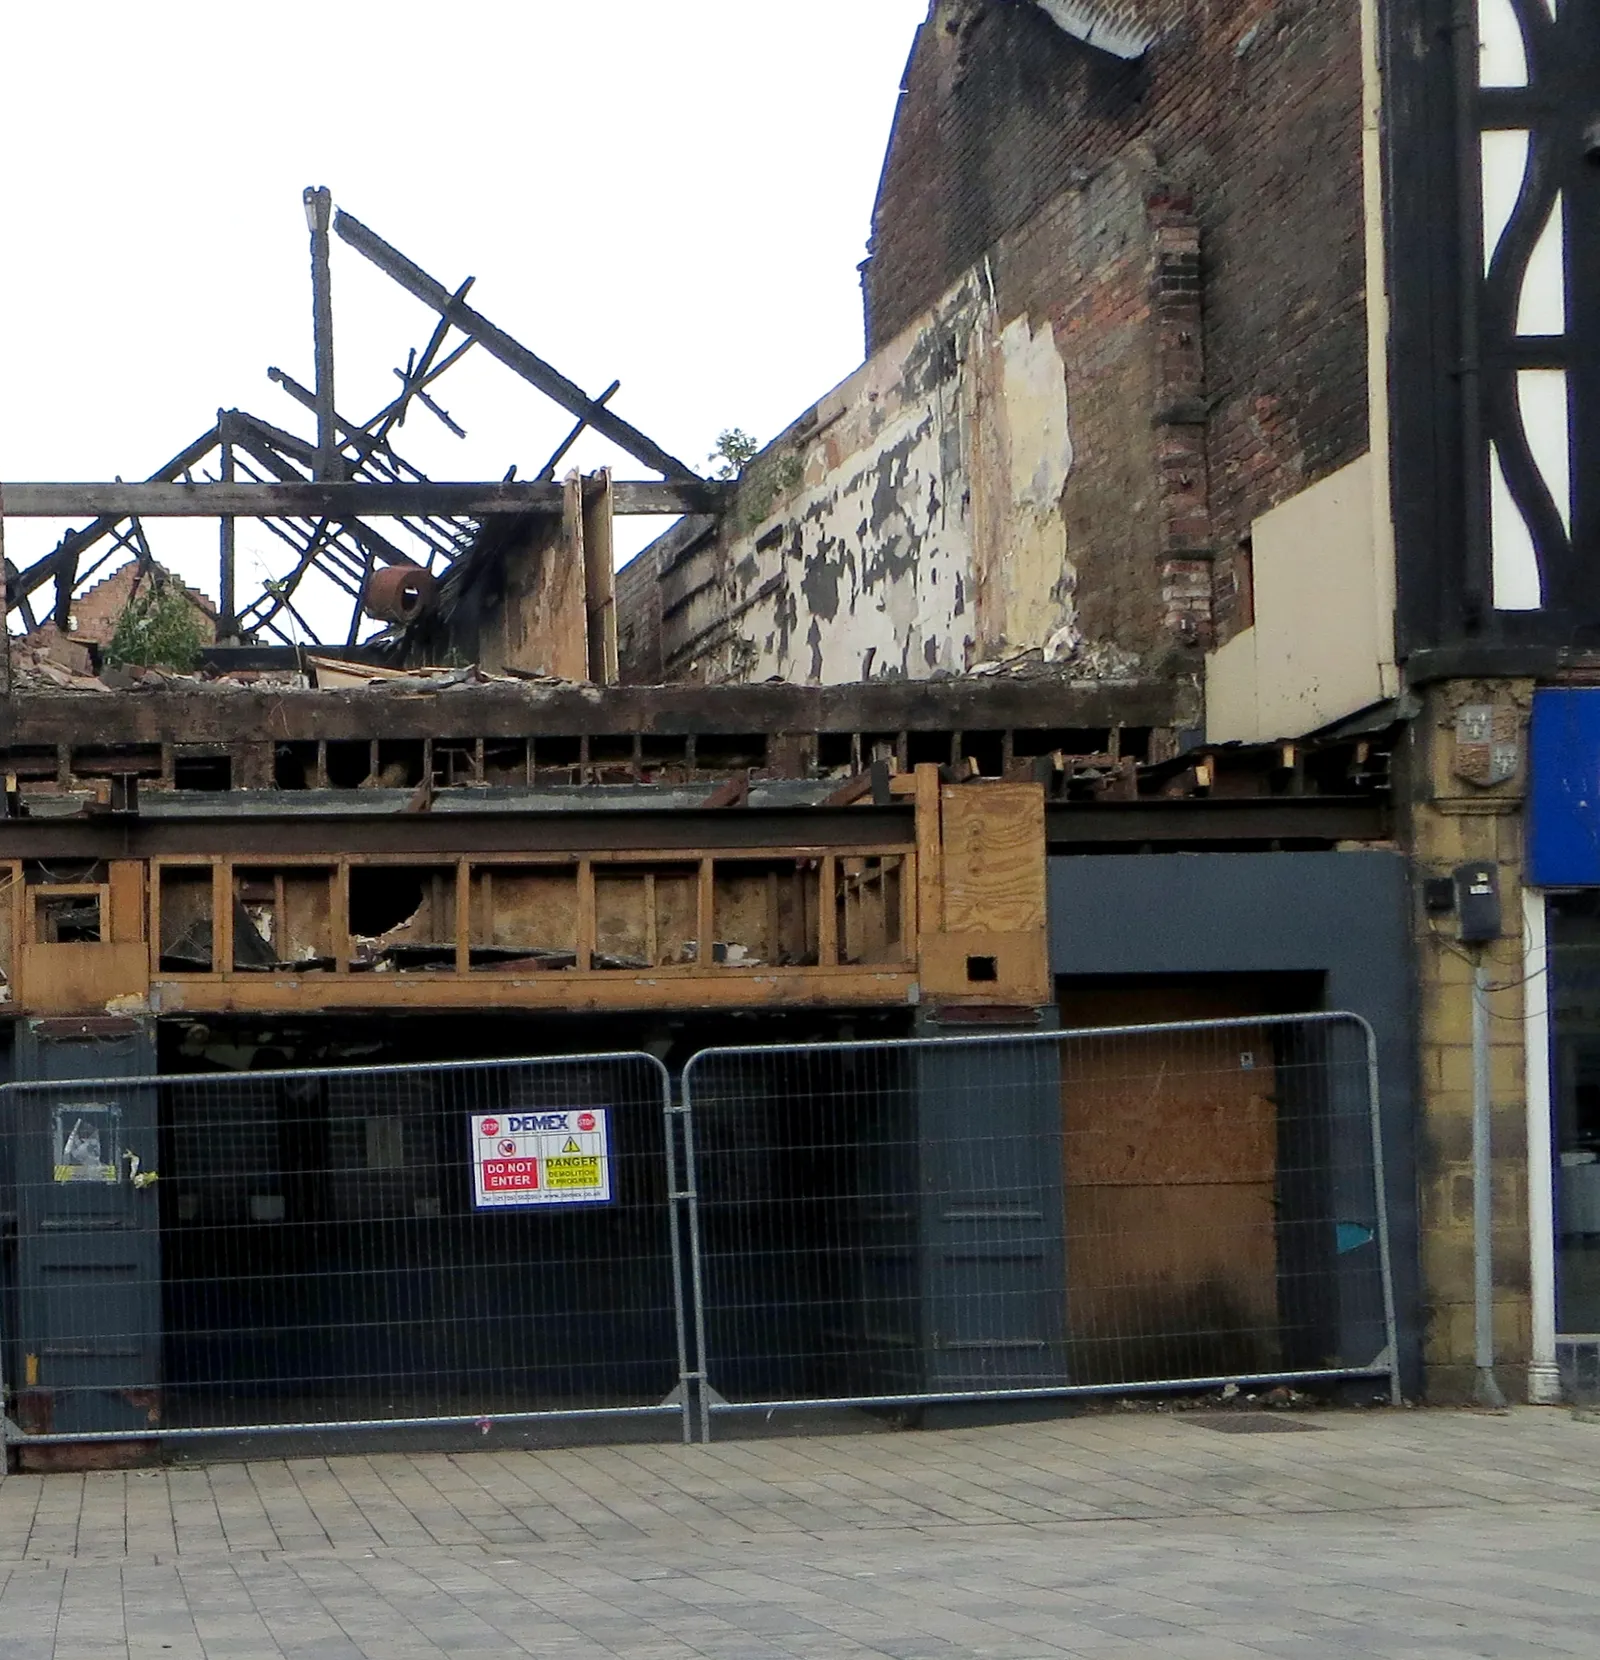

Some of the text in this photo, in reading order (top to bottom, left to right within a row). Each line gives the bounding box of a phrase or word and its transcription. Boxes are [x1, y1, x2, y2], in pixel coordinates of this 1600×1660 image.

[508, 1115, 568, 1132] DEMEX
[578, 1117, 595, 1126] STOP
[481, 1123, 498, 1132] STOP
[487, 1162, 532, 1174] DO NOT
[546, 1157, 597, 1168] DANGER
[548, 1170, 595, 1178] DEMOLITION
[491, 1175, 530, 1186] ENTER
